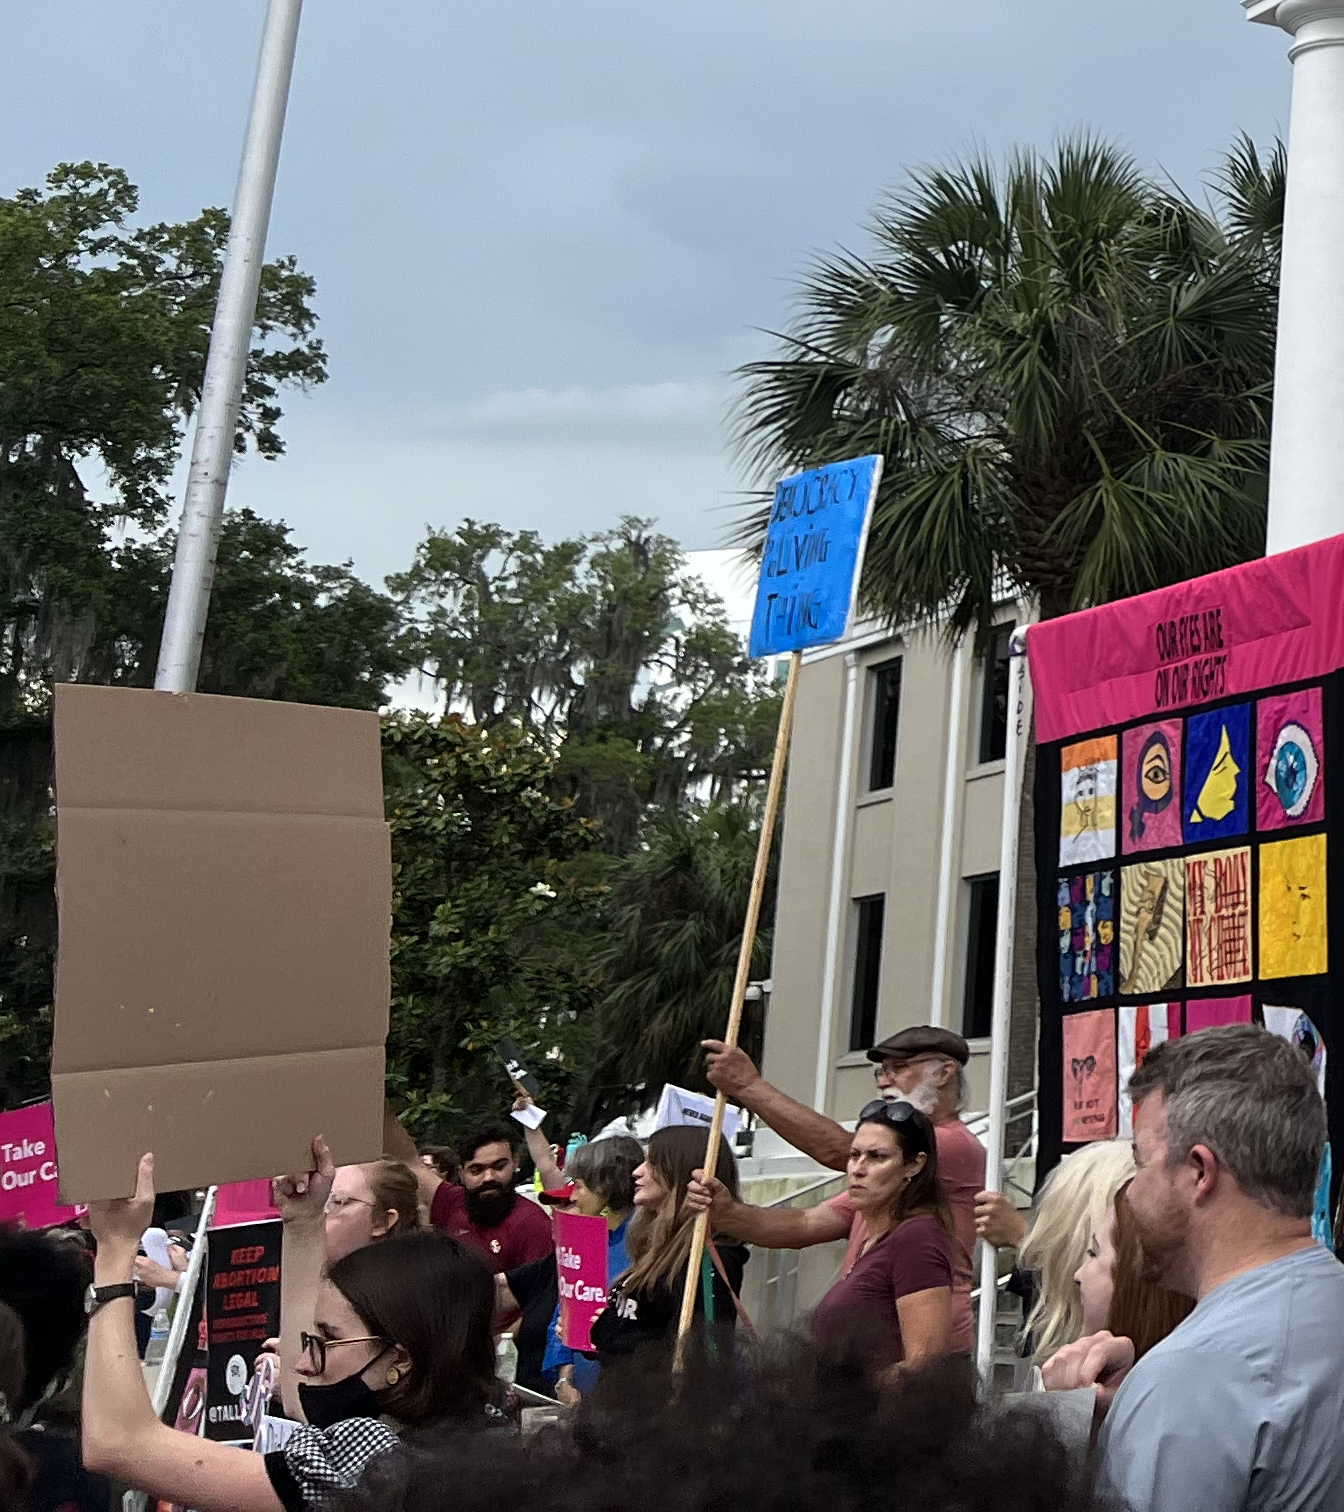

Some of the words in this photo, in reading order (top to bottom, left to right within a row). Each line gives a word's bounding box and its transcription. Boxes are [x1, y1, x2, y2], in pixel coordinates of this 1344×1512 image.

[1156, 620, 1179, 661] OUR
[1203, 608, 1224, 651] ARE
[0, 1139, 46, 1163] Take
[1, 1171, 37, 1191] Our
[575, 1279, 607, 1303] Care.
[208, 1405, 243, 1423] @TALL
